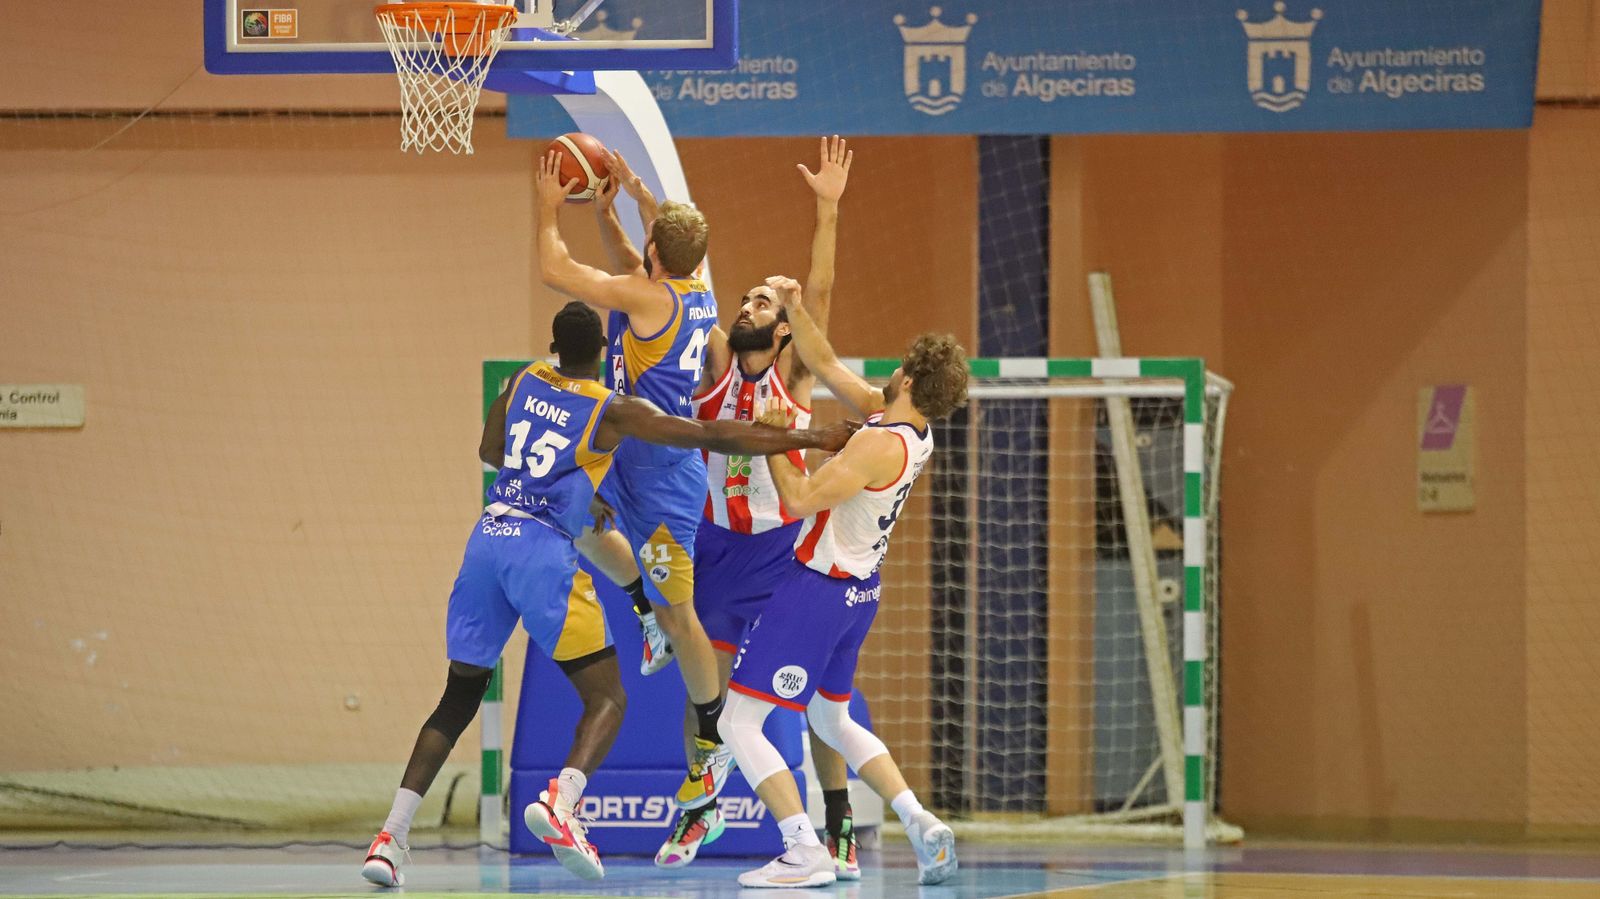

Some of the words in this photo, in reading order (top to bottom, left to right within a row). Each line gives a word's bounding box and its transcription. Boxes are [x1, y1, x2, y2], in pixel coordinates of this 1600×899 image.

[274, 14, 292, 23] FIBA
[981, 51, 1136, 76] Ayuntamiento
[1327, 47, 1485, 72] Ayuntamiento
[678, 76, 798, 105] Algeciras
[981, 79, 1008, 97] de
[1012, 73, 1136, 102] Algeciras
[1327, 75, 1352, 93] de
[1359, 69, 1485, 98] Algeciras
[679, 328, 710, 382] 4
[9, 391, 60, 404] Control
[524, 395, 571, 427] KONE
[504, 419, 571, 478] 15
[639, 543, 672, 563] 41
